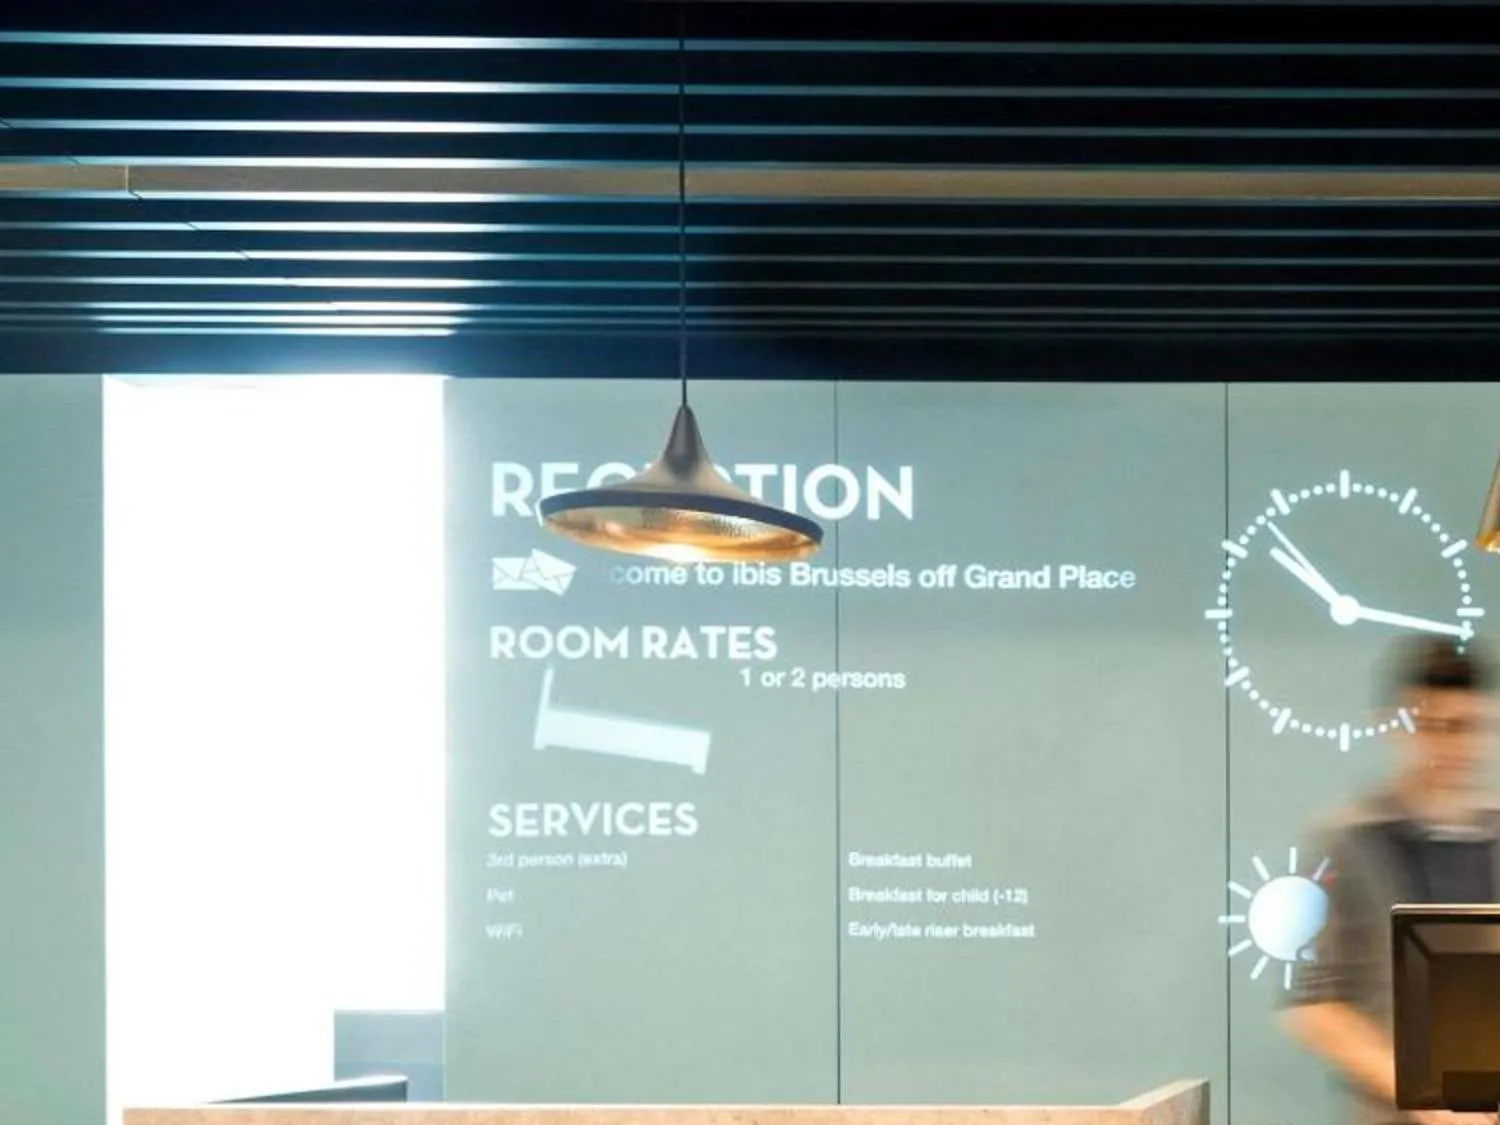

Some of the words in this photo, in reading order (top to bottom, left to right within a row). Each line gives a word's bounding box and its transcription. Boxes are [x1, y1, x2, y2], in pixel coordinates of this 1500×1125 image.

[490, 462, 914, 521] RETION
[694, 562, 724, 586] to
[790, 561, 911, 588] Brussels
[918, 563, 957, 588] off
[964, 563, 1051, 589] Grand
[1059, 564, 1137, 589] Place
[490, 625, 629, 659] ROOM
[641, 625, 778, 660] RATES
[739, 667, 751, 687] 1
[760, 670, 786, 688] or
[790, 666, 806, 688] 2
[812, 670, 907, 692] persons
[488, 801, 699, 838] SERVICES
[517, 853, 574, 869] person
[848, 851, 923, 868] Breakfast
[926, 853, 973, 869] buffet
[848, 886, 923, 903] Breakfast
[926, 887, 948, 903] for
[952, 887, 989, 903] child
[848, 920, 922, 942] Early/late
[925, 922, 959, 937] riser
[963, 922, 1035, 938] breakfast
